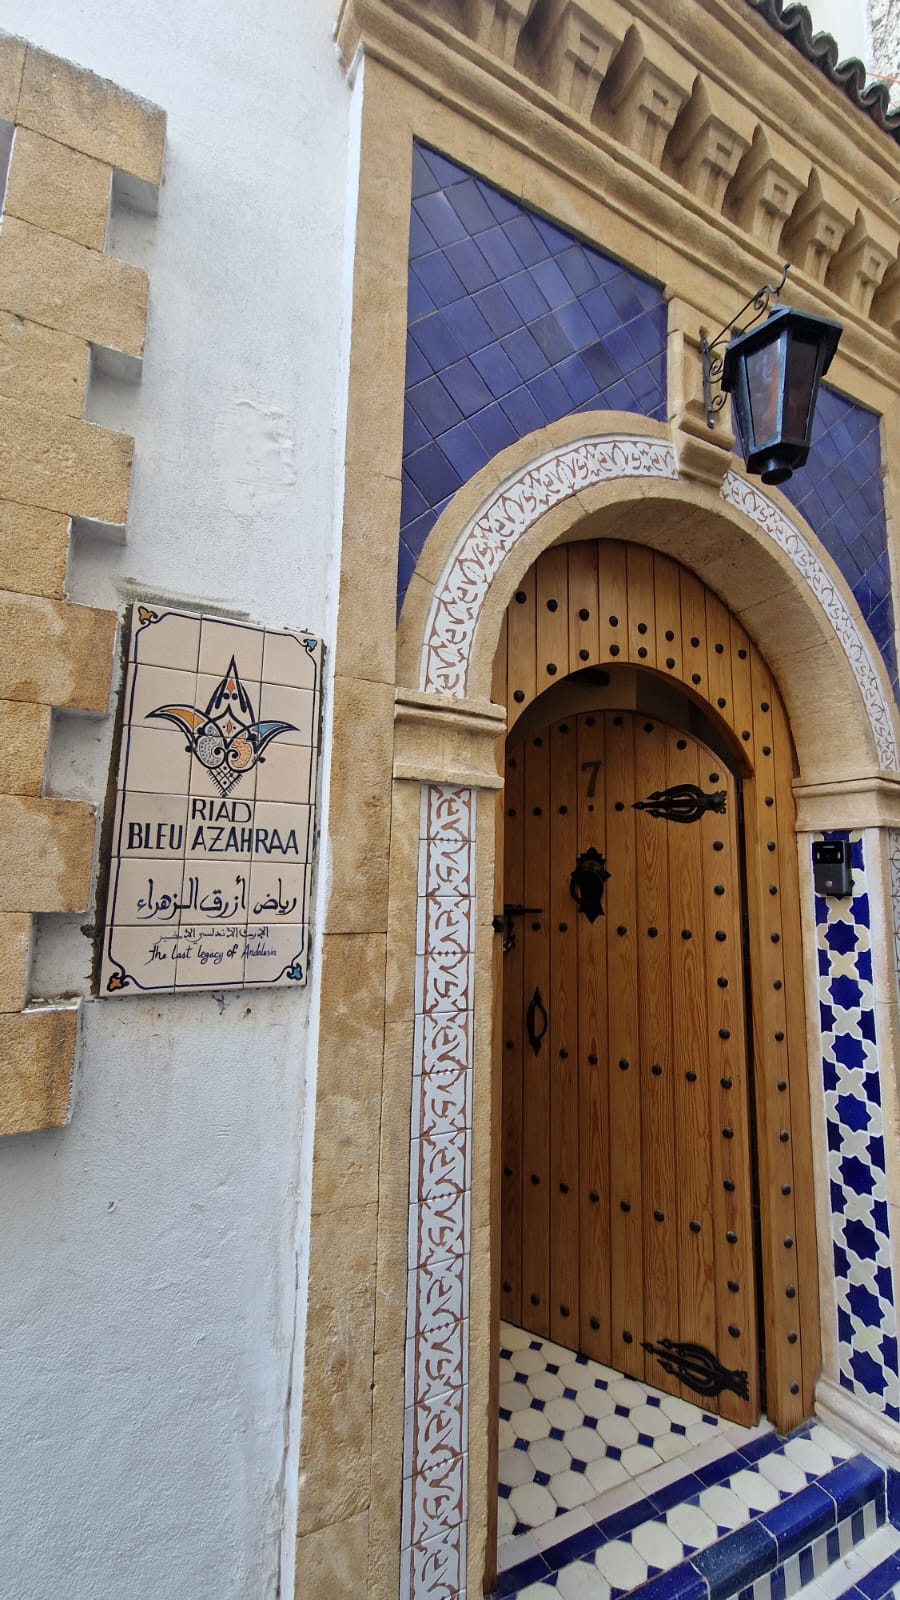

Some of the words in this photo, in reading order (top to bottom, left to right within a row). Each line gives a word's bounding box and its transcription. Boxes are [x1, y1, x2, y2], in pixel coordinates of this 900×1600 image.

[581, 760, 602, 798] 7
[191, 798, 252, 823] RIAD
[126, 822, 183, 850] BLEU
[191, 825, 299, 855] AZAHRAA
[136, 877, 199, 920] الزهراء
[253, 878, 297, 915] رياض
[197, 944, 224, 965] legacy
[226, 943, 239, 959] of
